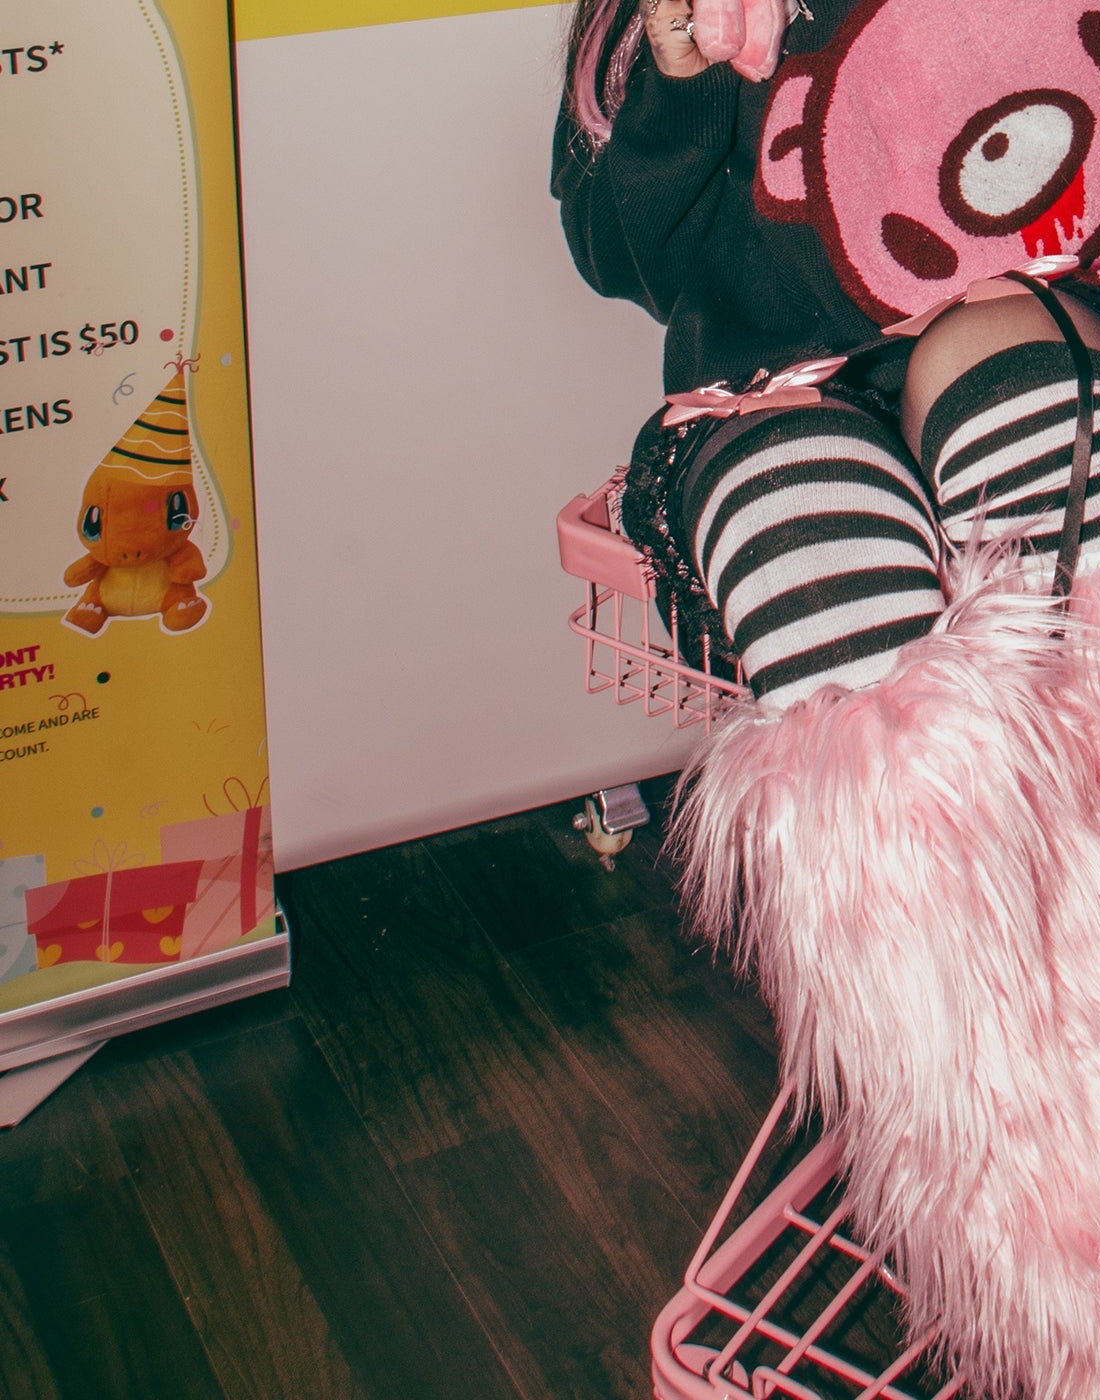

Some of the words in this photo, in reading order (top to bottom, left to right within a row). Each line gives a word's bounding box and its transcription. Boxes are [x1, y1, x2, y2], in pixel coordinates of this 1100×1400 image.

[40, 331, 72, 358] IS
[80, 320, 139, 355] $50
[38, 714, 69, 731] AND
[72, 707, 100, 723] ARE
